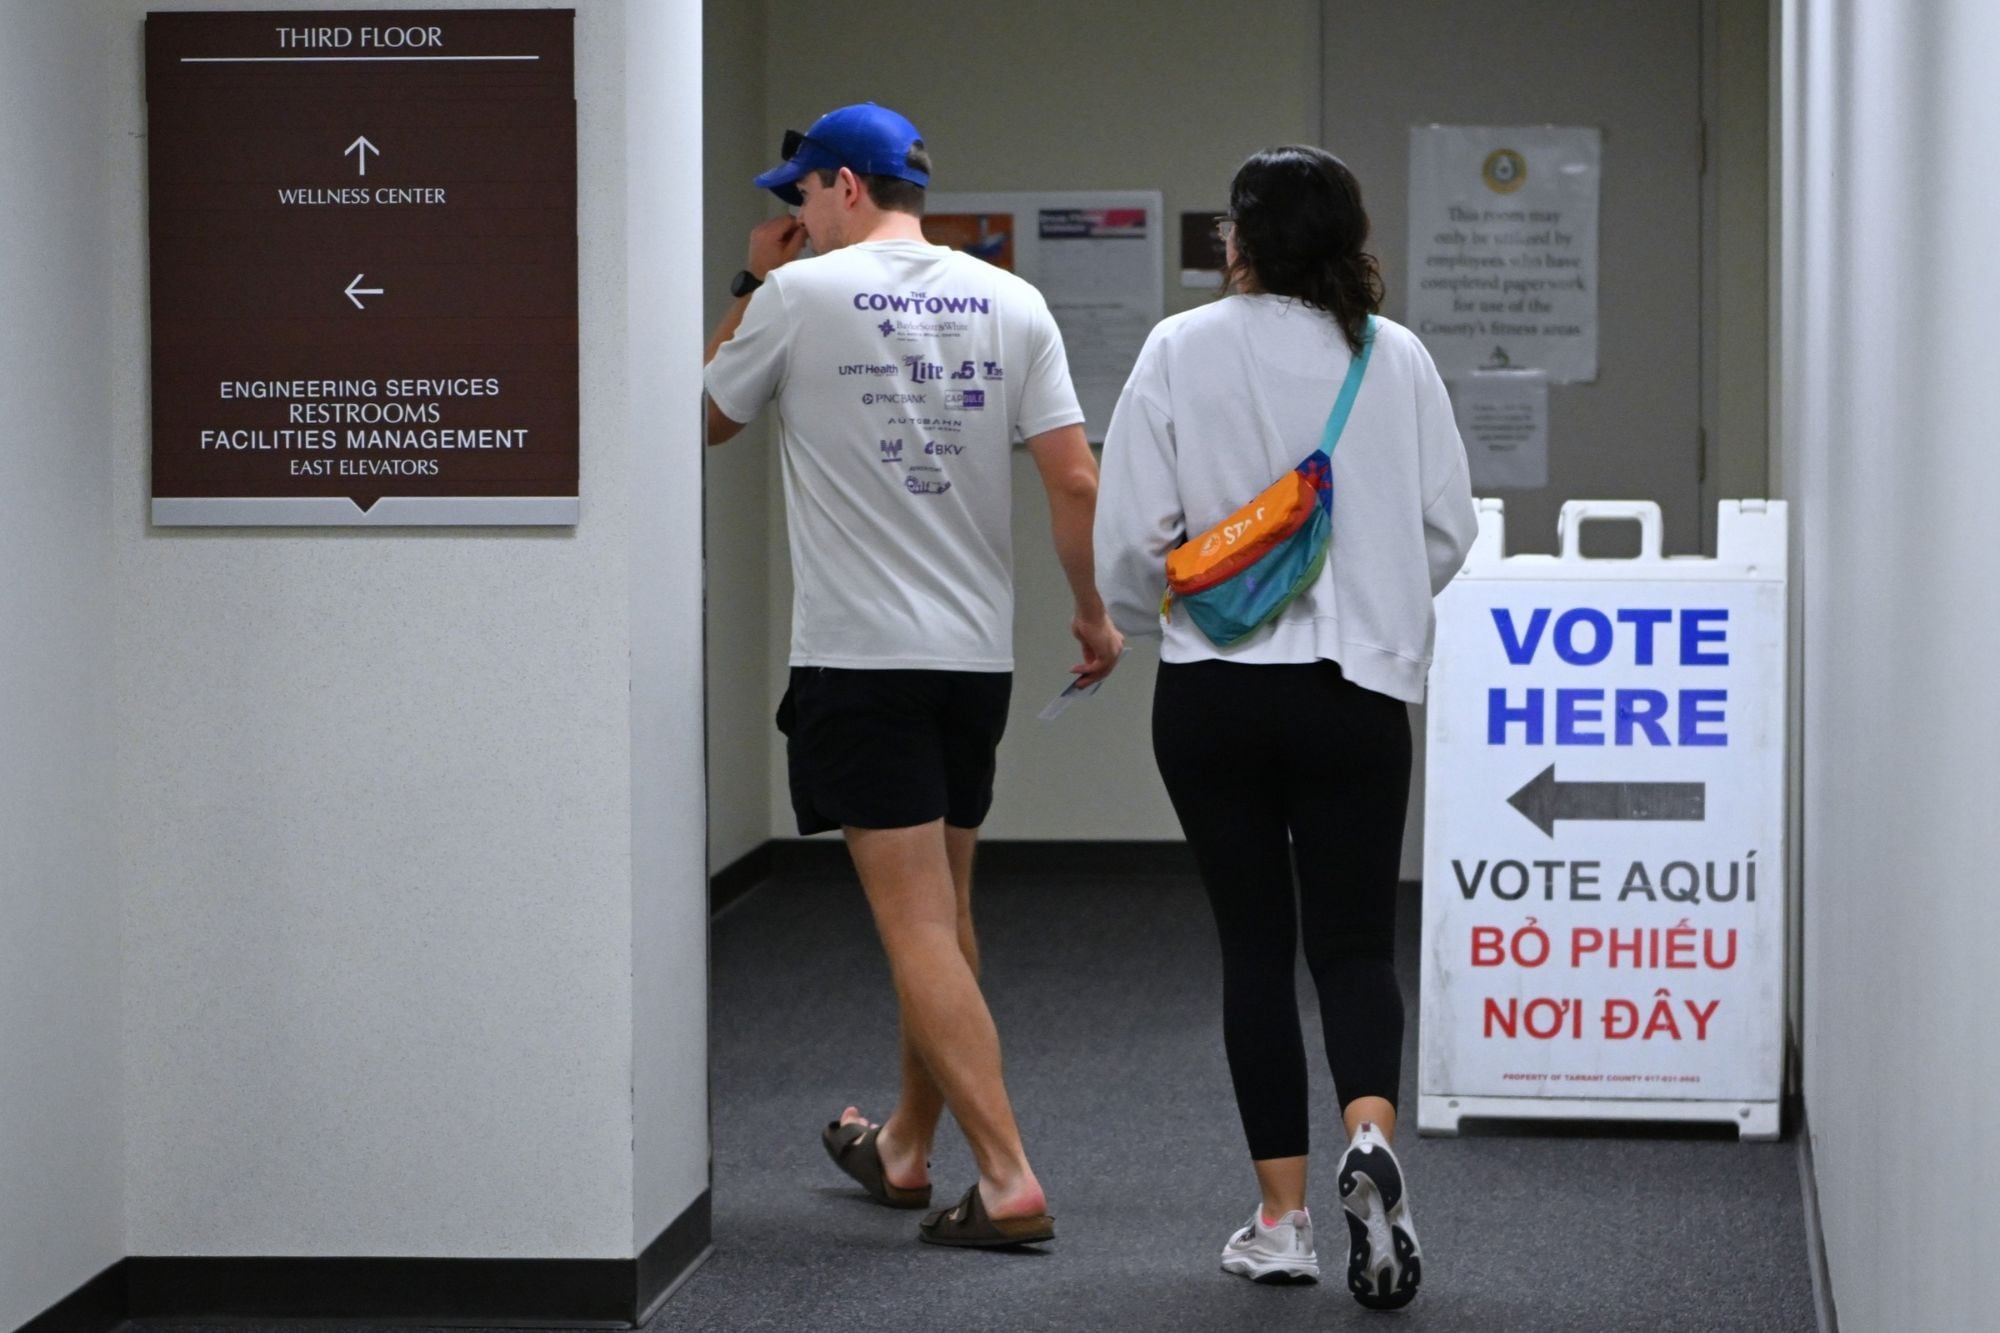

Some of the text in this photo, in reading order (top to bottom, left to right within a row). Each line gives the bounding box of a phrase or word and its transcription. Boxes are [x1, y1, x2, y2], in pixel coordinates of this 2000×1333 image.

[276, 26, 443, 48] THIRD FLOOR
[278, 188, 446, 205] WELLNESS CENTER
[853, 293, 989, 315] COWTOWN
[838, 364, 898, 376] UNT Health
[909, 361, 943, 384] Lite
[220, 378, 500, 399] ENGINEERING SERVICES
[289, 403, 441, 424] RESTROOMS
[888, 417, 962, 427] AUTOBAHN
[201, 428, 529, 450] FACILITIES MANAGEMENT
[935, 444, 964, 455] BKV
[290, 459, 440, 476] EAST ELEVATORS
[1491, 607, 1730, 667] VOTE
[1487, 688, 1728, 747] HERE
[1452, 850, 1758, 904] VOTE AQUÍ
[1471, 917, 1738, 969] BỎ PHIẾU
[1485, 988, 1721, 1041] NƠI ĐÂY
[1503, 1073, 1548, 1081] PROPERTY
[1550, 1073, 1561, 1081] OF
